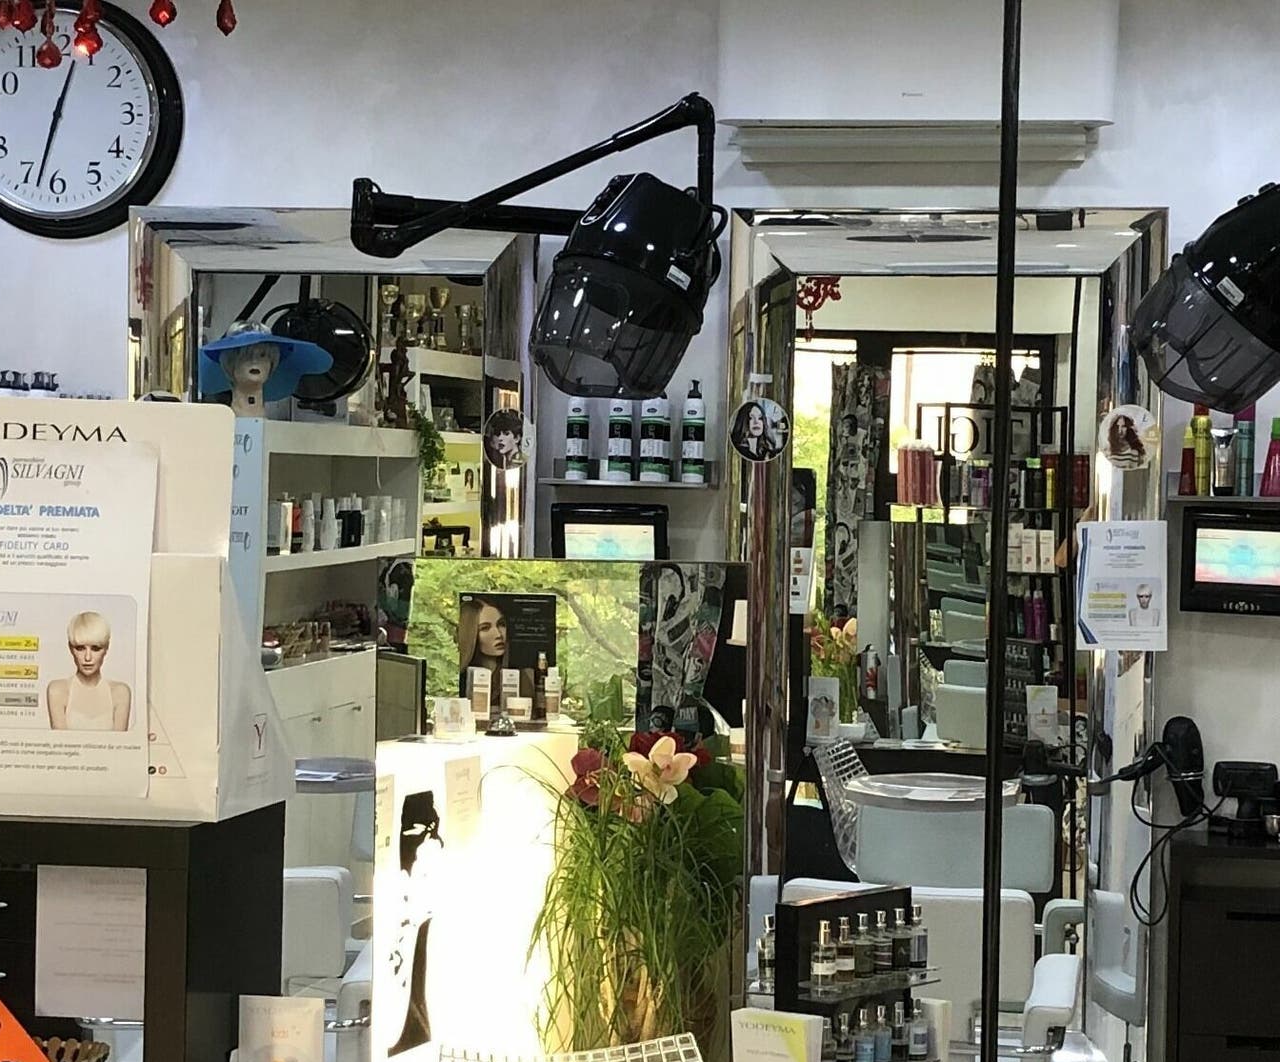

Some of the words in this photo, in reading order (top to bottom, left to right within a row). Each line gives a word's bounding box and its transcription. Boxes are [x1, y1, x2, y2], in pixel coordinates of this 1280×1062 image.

[17, 45, 37, 68] 11
[107, 65, 122, 89] 2
[121, 102, 135, 126] 3
[107, 135, 124, 159] 4
[20, 161, 35, 185] 7
[49, 169, 67, 195] 6
[86, 161, 102, 185] 5
[11, 463, 85, 480] SILVAGNI
[39, 505, 100, 518] PREMIATA
[0, 541, 38, 550] FIDELITY
[43, 542, 69, 551] CARD
